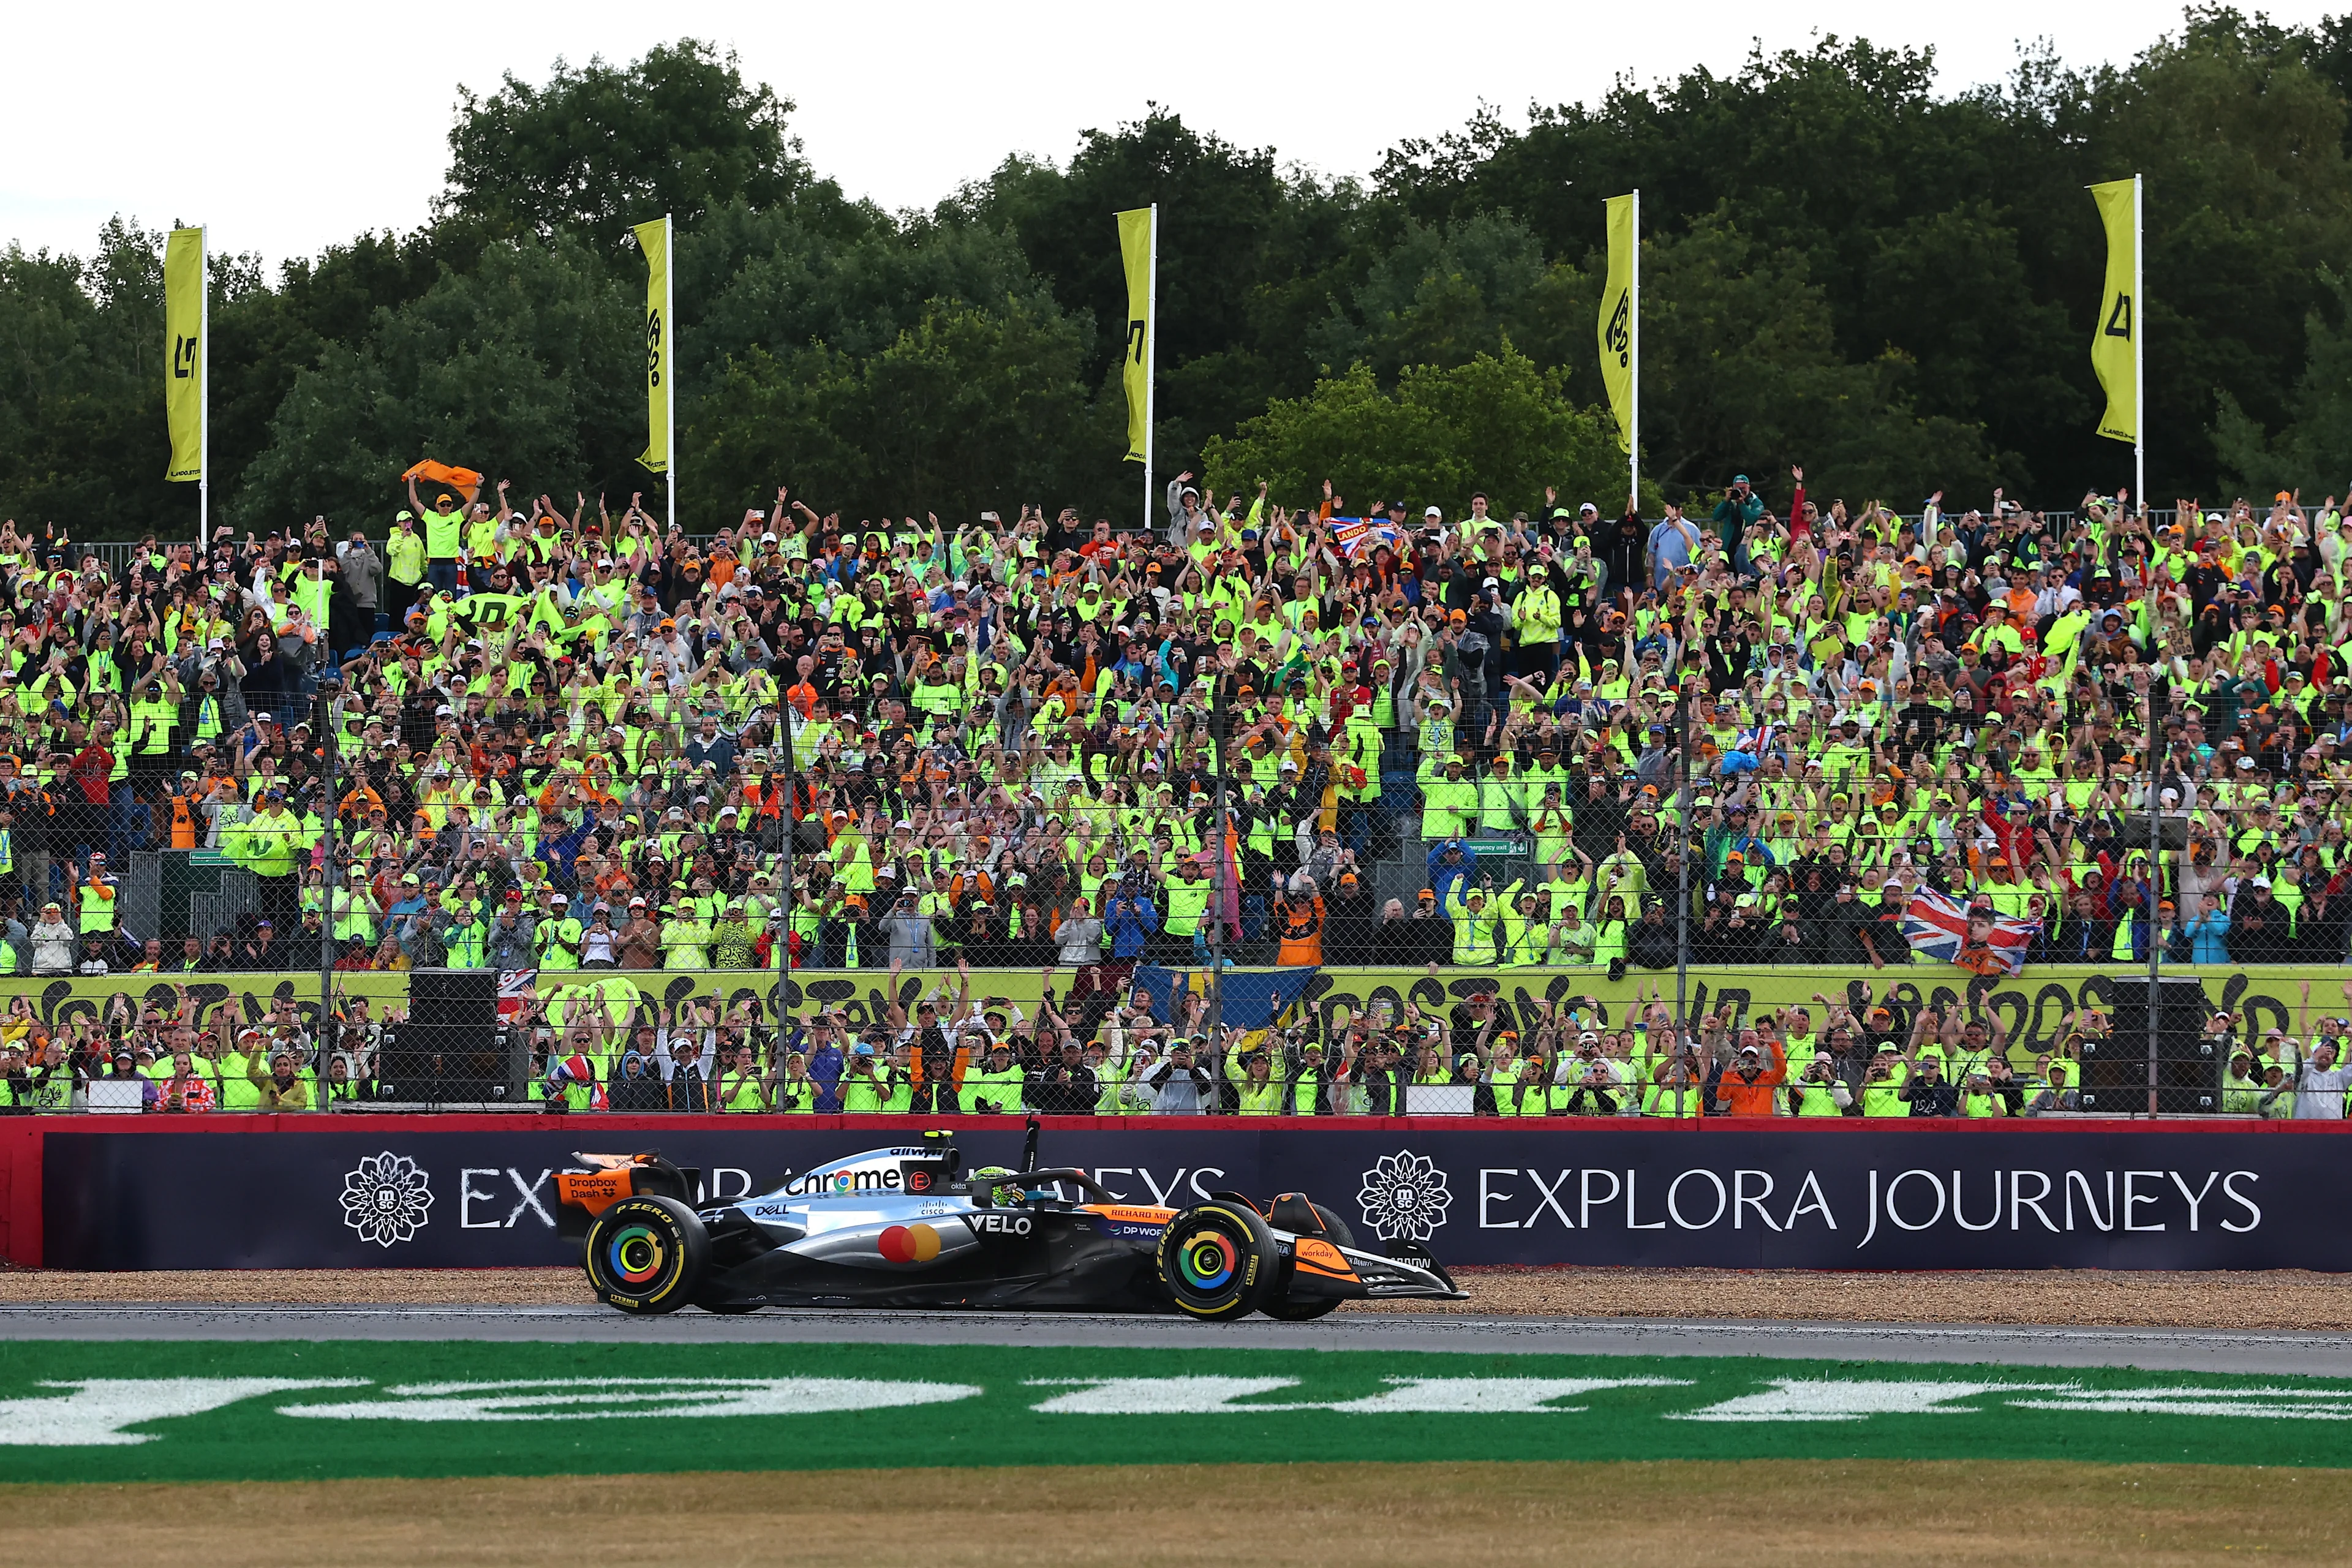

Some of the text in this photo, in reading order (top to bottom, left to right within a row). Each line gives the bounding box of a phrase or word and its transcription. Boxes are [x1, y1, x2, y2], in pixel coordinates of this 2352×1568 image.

[1337, 526, 1366, 540] LANDO
[889, 1147, 941, 1158] allwyn
[570, 1178, 617, 1190] Dropbox
[571, 1189, 600, 1198] Dash
[616, 1202, 673, 1224] P ZERO
[755, 1204, 789, 1216] DELL
[1112, 1209, 1152, 1218] RICHARD
[1479, 1168, 2261, 1250] EXPLORA JOURNEYS
[968, 1215, 1031, 1235] VELO
[1156, 1223, 1175, 1282] P ZERO
[1302, 1250, 1333, 1259] workday
[1245, 1254, 1259, 1286] PIRELLI
[610, 1294, 639, 1308] PIRELLI
